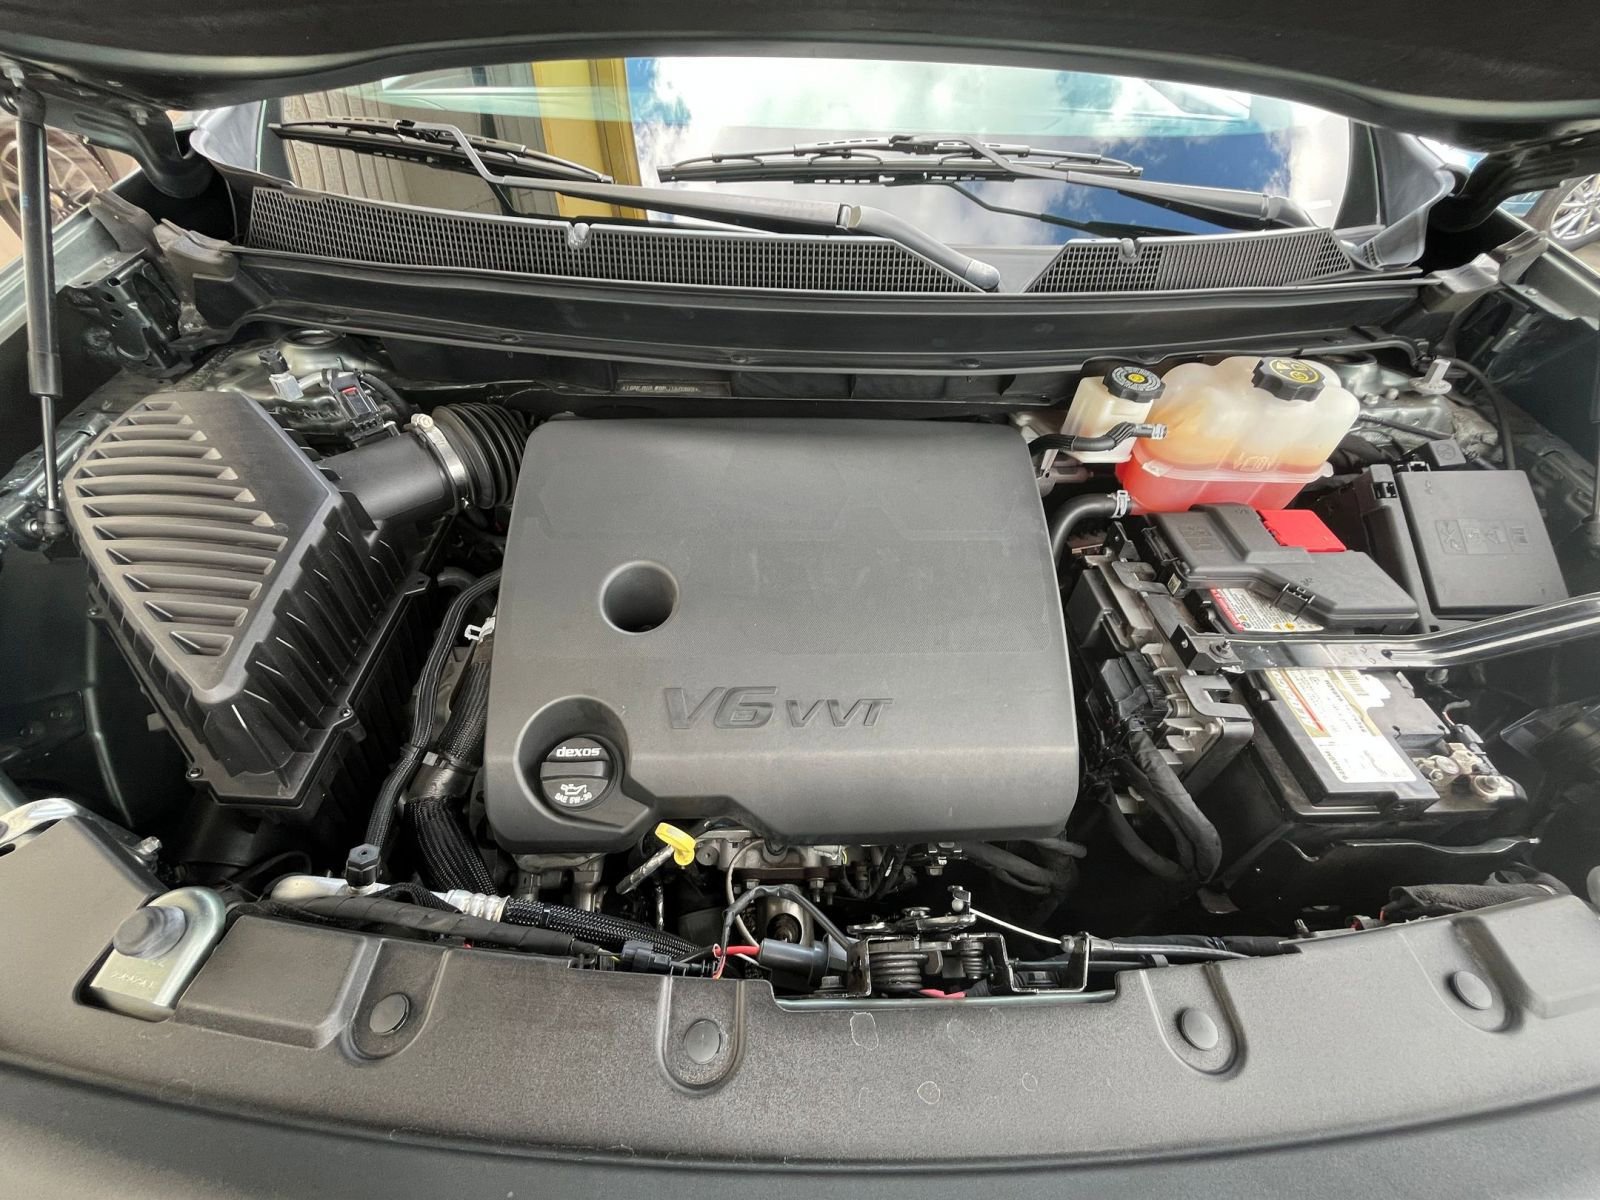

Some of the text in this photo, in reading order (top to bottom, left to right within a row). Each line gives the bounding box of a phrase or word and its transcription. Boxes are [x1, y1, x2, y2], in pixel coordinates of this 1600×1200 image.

[663, 686, 894, 729] V6 VVT
[556, 746, 602, 757] dexos
